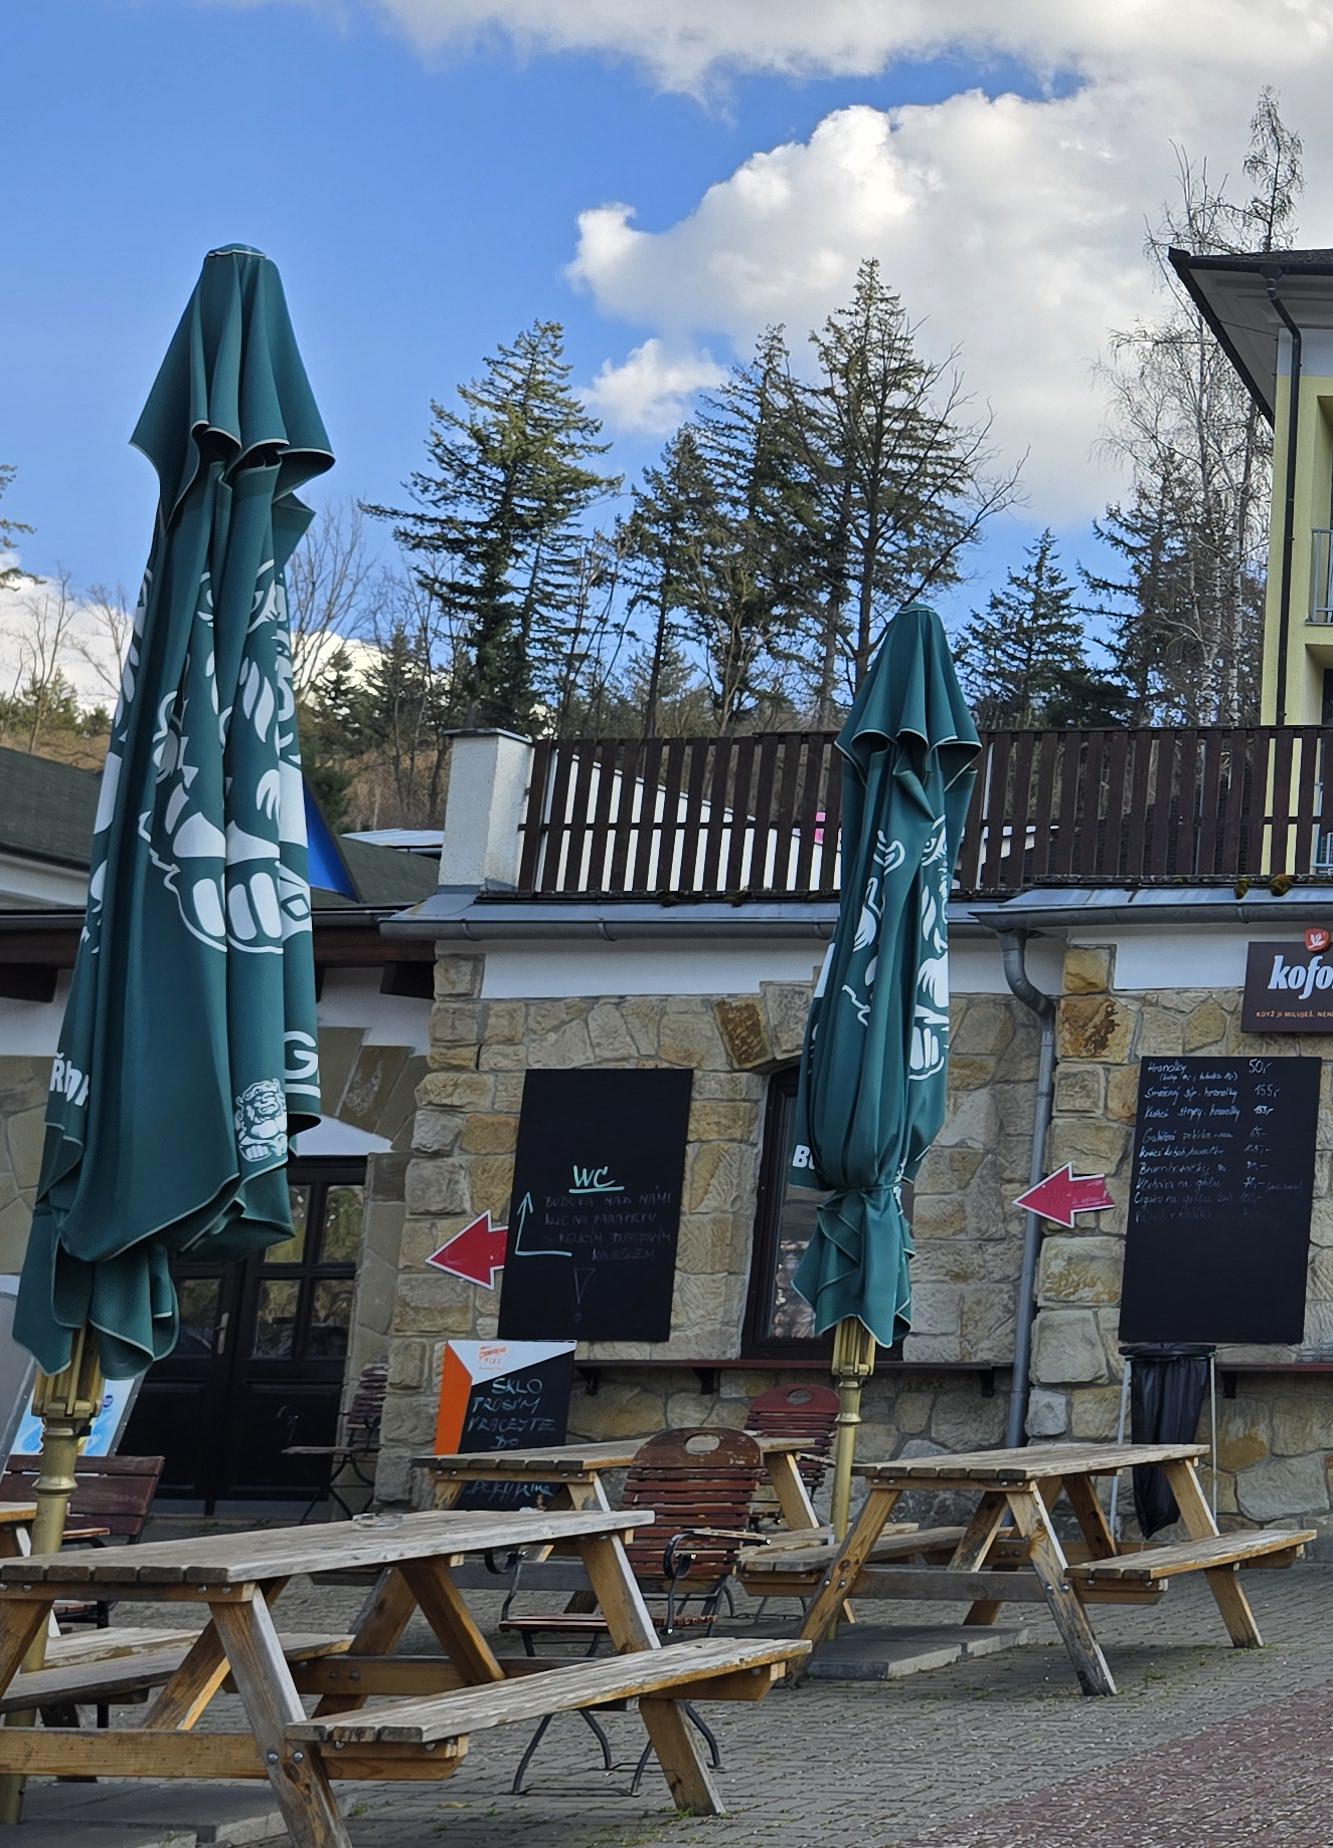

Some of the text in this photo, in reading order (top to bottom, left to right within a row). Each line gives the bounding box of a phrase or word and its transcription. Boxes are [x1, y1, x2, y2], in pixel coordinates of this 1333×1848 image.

[1256, 1010, 1276, 1018] KDYŽ
[1276, 1011, 1283, 1019] JI
[573, 1164, 617, 1188] WC
